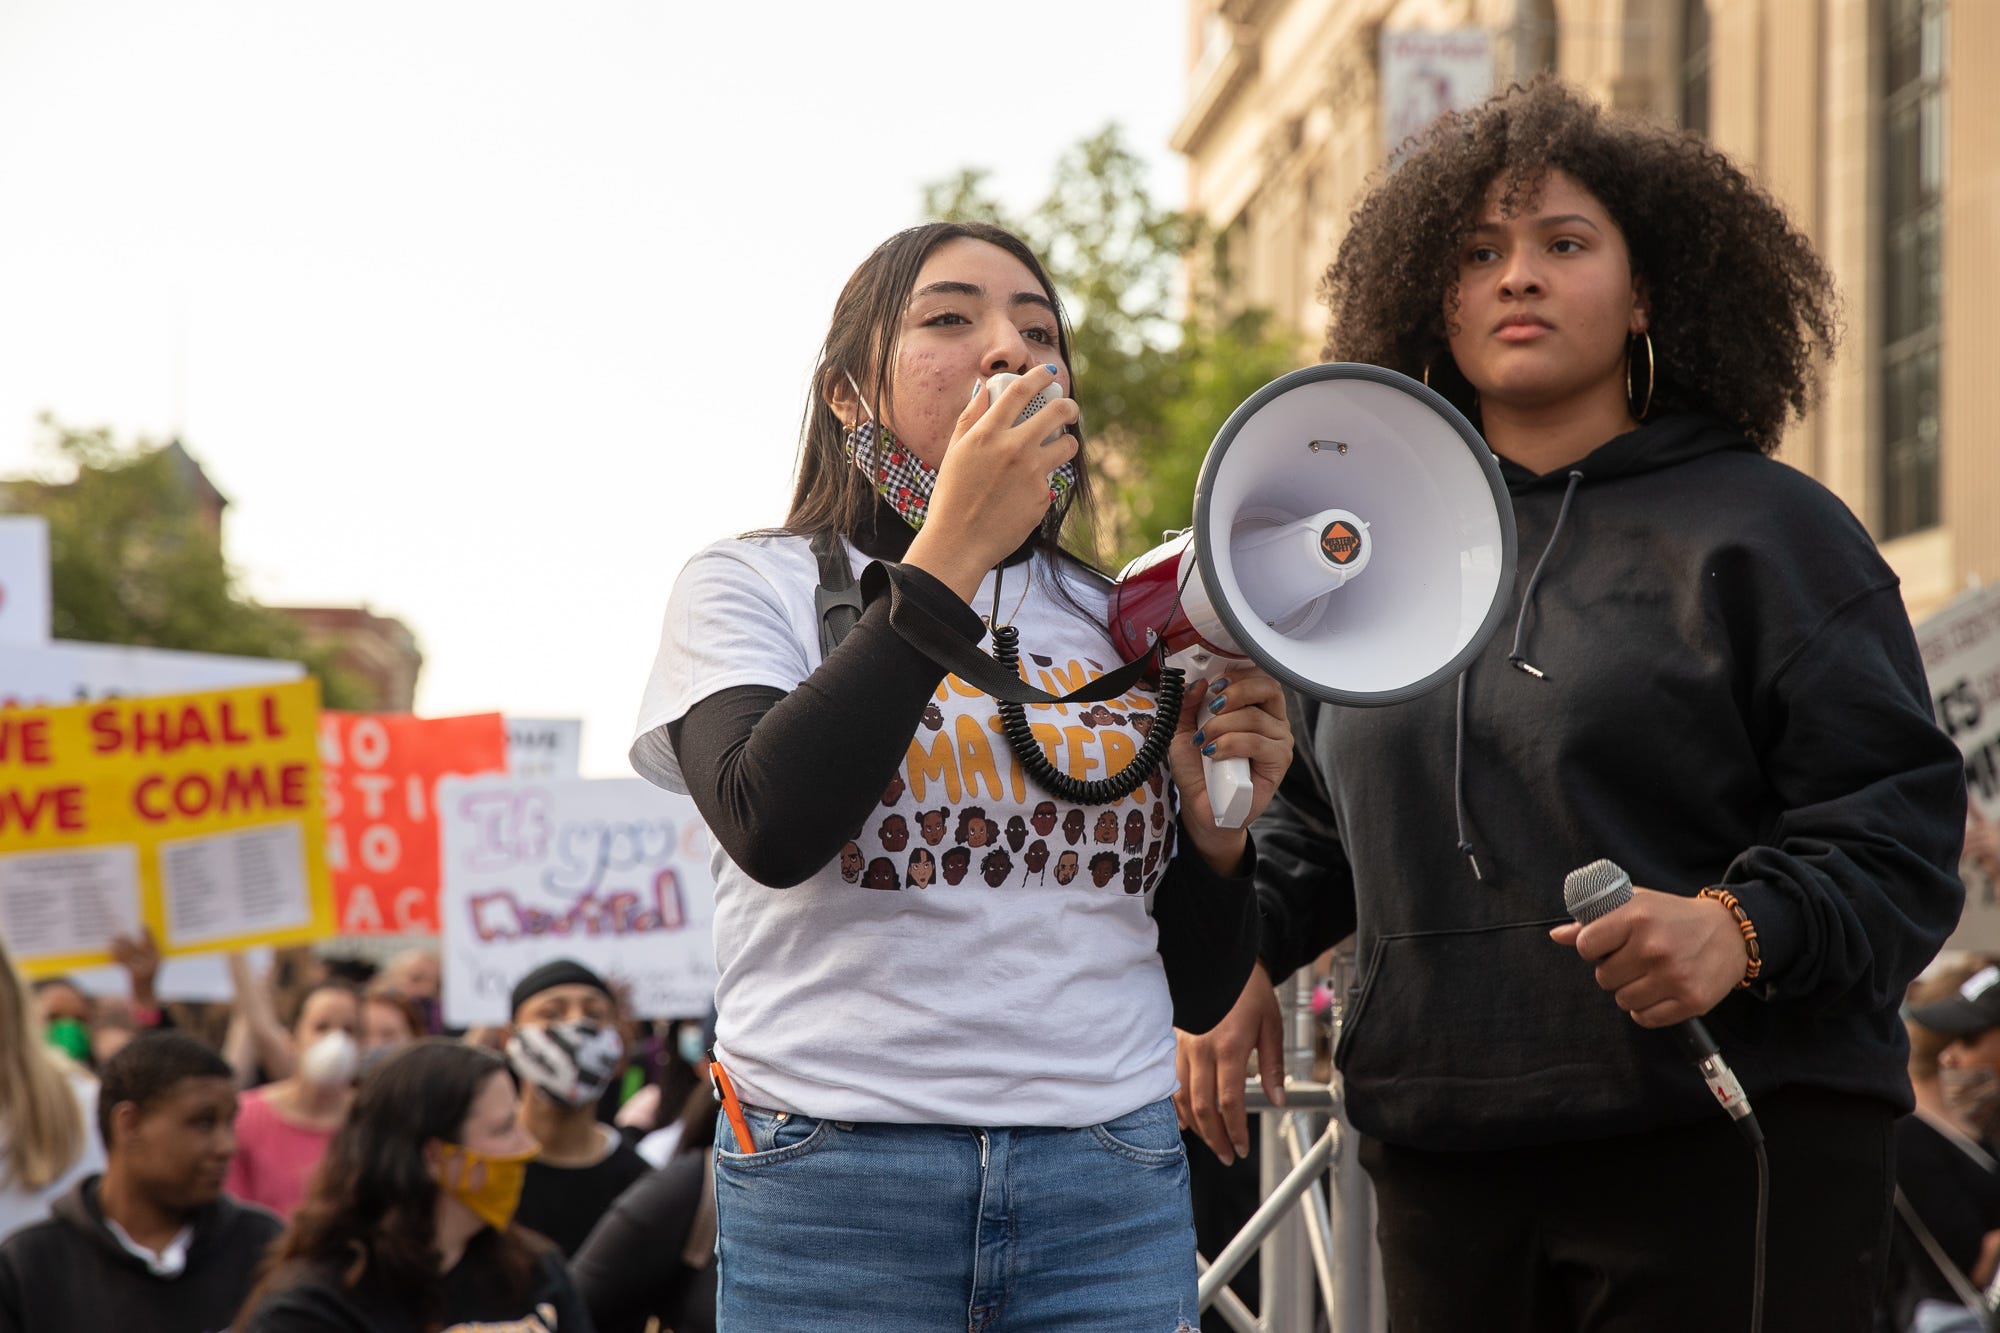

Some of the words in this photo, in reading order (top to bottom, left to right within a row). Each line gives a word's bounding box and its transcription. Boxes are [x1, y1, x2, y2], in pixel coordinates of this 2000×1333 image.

[0, 718, 50, 768] E
[87, 694, 285, 755] SHALL
[0, 784, 86, 836] VE
[132, 762, 309, 823] COME
